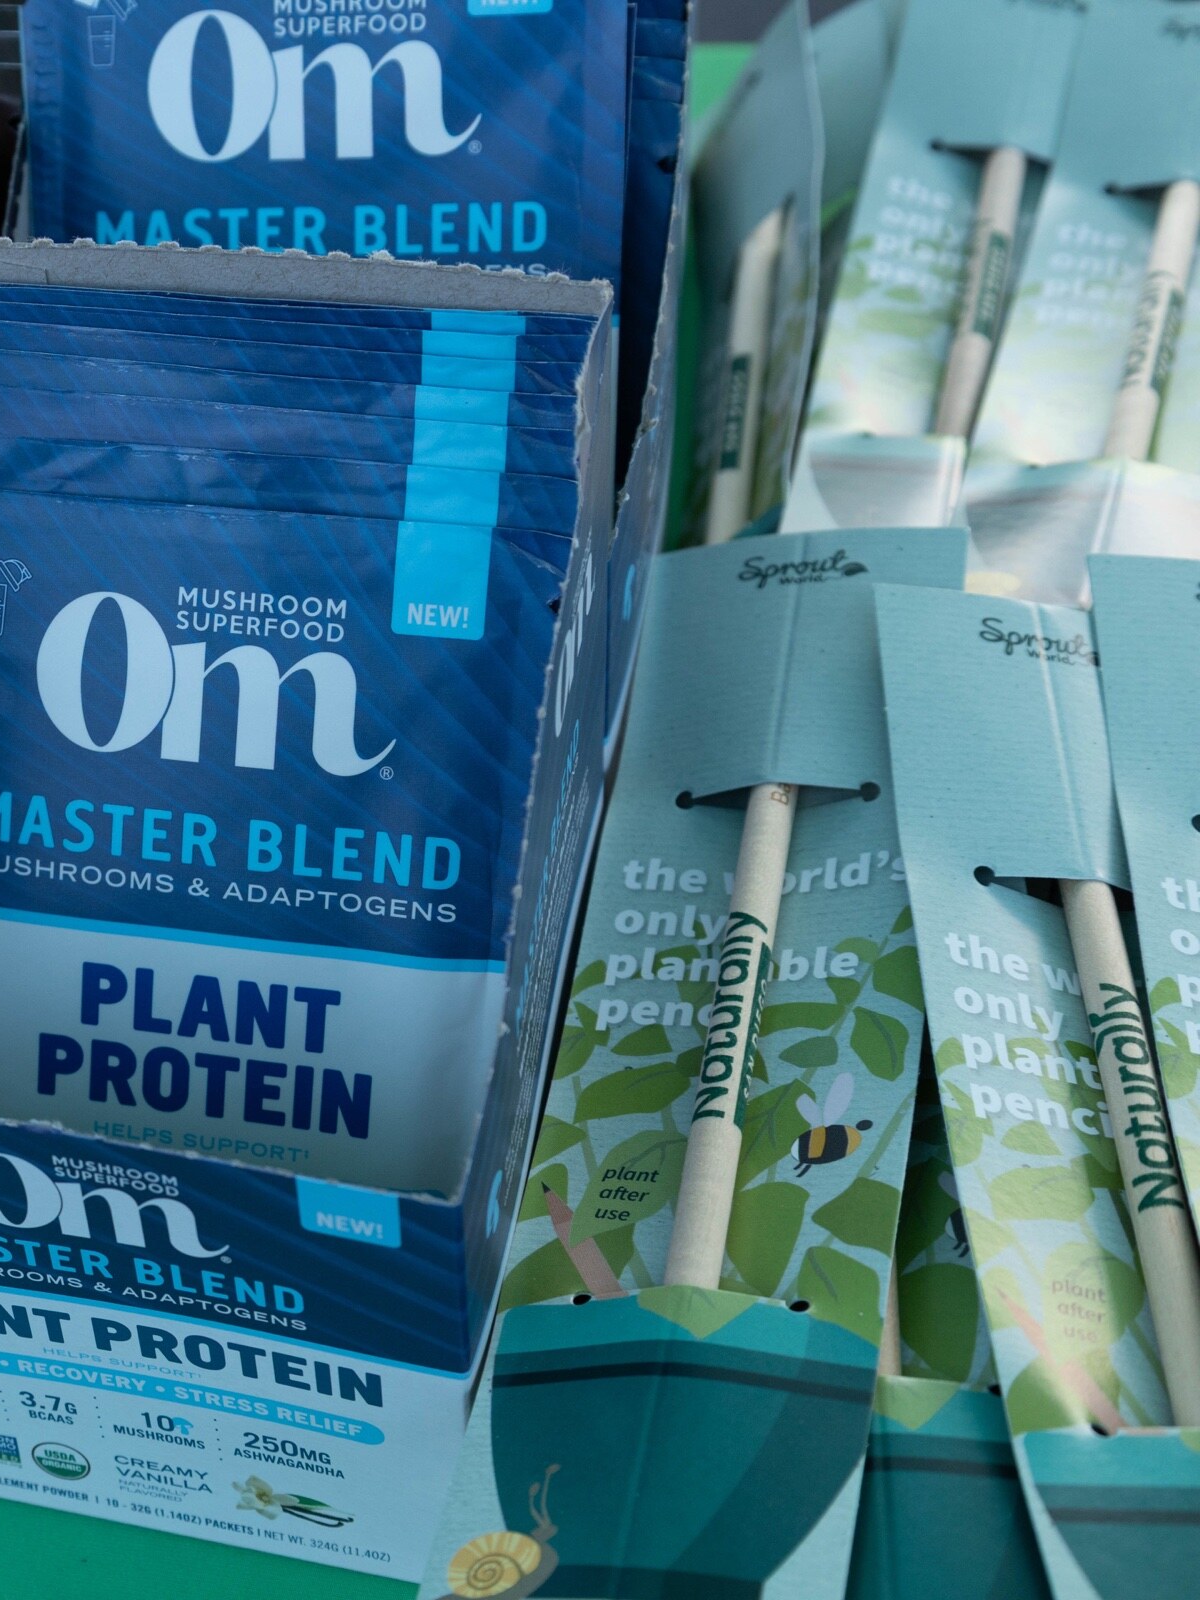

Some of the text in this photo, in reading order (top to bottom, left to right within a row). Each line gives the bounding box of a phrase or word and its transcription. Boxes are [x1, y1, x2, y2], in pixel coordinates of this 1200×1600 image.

[274, 12, 427, 37] SUPERFOOD
[148, 8, 482, 163] Om
[96, 201, 548, 256] MASTER BLEND
[738, 549, 848, 589] Sprout
[177, 586, 348, 620] MUSHROOM
[406, 603, 470, 629] NEW!
[176, 611, 346, 643] SUPERFOOD
[980, 617, 1090, 657] Sprout
[36, 591, 397, 777] Om
[247, 819, 462, 890] BLEND
[623, 858, 708, 893] the
[187, 877, 211, 899] &
[222, 882, 458, 923] ADAPTOGENS
[614, 904, 728, 945] only
[604, 945, 860, 987] planble
[944, 931, 1031, 982] the
[80, 961, 342, 1054] PLANT
[692, 910, 769, 1122] Naturally
[954, 986, 1064, 1043] only
[37, 1032, 373, 1139] PROTEIN
[1099, 982, 1184, 1213] Naturally
[969, 1081, 1114, 1140] penci
[93, 1120, 174, 1145] HELPS
[52, 1155, 178, 1187] MUSHROOM
[54, 1167, 180, 1197] SUPERFOOD
[601, 1165, 660, 1184] plant
[598, 1186, 650, 1204] after
[316, 1211, 384, 1239] NEW!
[593, 1204, 632, 1222] use
[133, 1257, 304, 1314] BLEND
[1051, 1279, 1107, 1304] plant
[94, 1281, 113, 1293] &
[122, 1286, 307, 1330] ADAPTOGENS
[1057, 1302, 1106, 1323] after
[43, 1347, 102, 1362] HELPS
[91, 1317, 383, 1407] PROTEIN
[17, 1359, 147, 1392] RECOVERY
[175, 1387, 269, 1416] STRESS
[277, 1404, 363, 1437] RELIEF
[18, 1390, 78, 1415] 3.7G
[28, 1409, 75, 1426] BCAAS
[140, 1412, 175, 1432] 10
[113, 1424, 205, 1450] MUSHROOMS
[243, 1431, 331, 1466] 250MG
[41, 1459, 83, 1473] ORGANIC
[44, 1449, 76, 1462] USDA
[114, 1455, 209, 1480] CREAMY
[233, 1448, 346, 1480] ASHWAGANDHA
[116, 1466, 213, 1494] VANILLA
[118, 1479, 188, 1497] NATURALLY
[119, 1486, 183, 1502] FLAVORED
[42, 1484, 89, 1502] POWDER
[205, 1517, 254, 1535] PACKETS
[264, 1530, 284, 1542] NET
[310, 1539, 339, 1553] 324G
